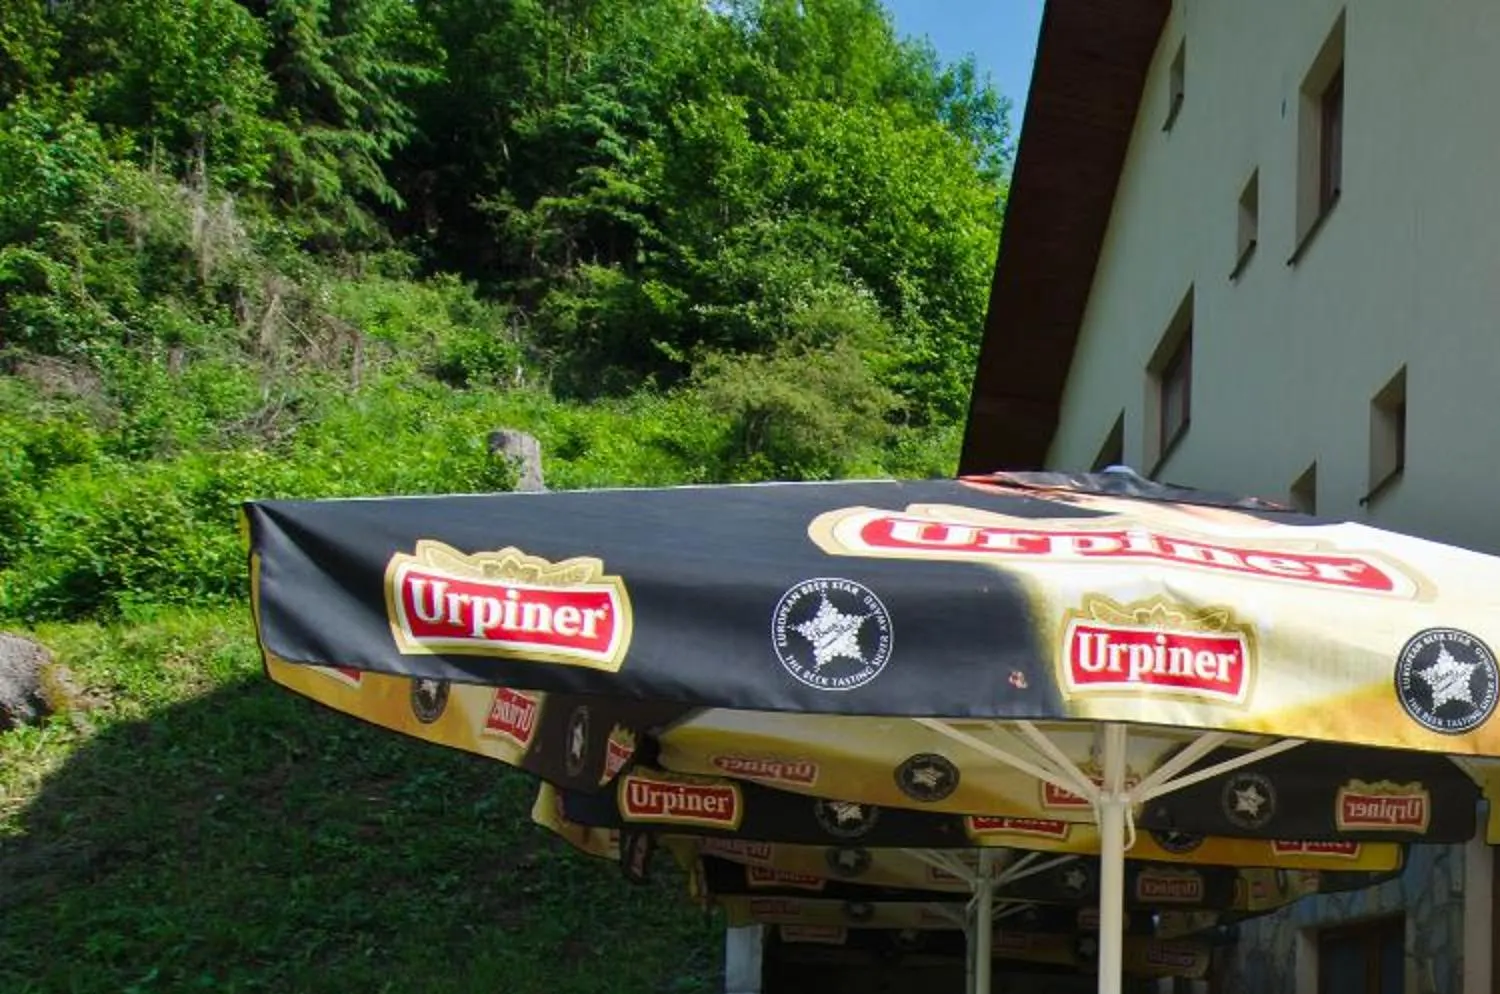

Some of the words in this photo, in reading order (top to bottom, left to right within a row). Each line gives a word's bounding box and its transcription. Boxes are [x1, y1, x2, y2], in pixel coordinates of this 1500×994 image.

[884, 516, 1368, 583] Urpiner
[408, 577, 607, 638] Urpiner
[800, 581, 829, 596] BEER
[831, 581, 860, 596] STAR
[1077, 631, 1237, 683] Urpiner
[630, 783, 729, 815] Urpiner
